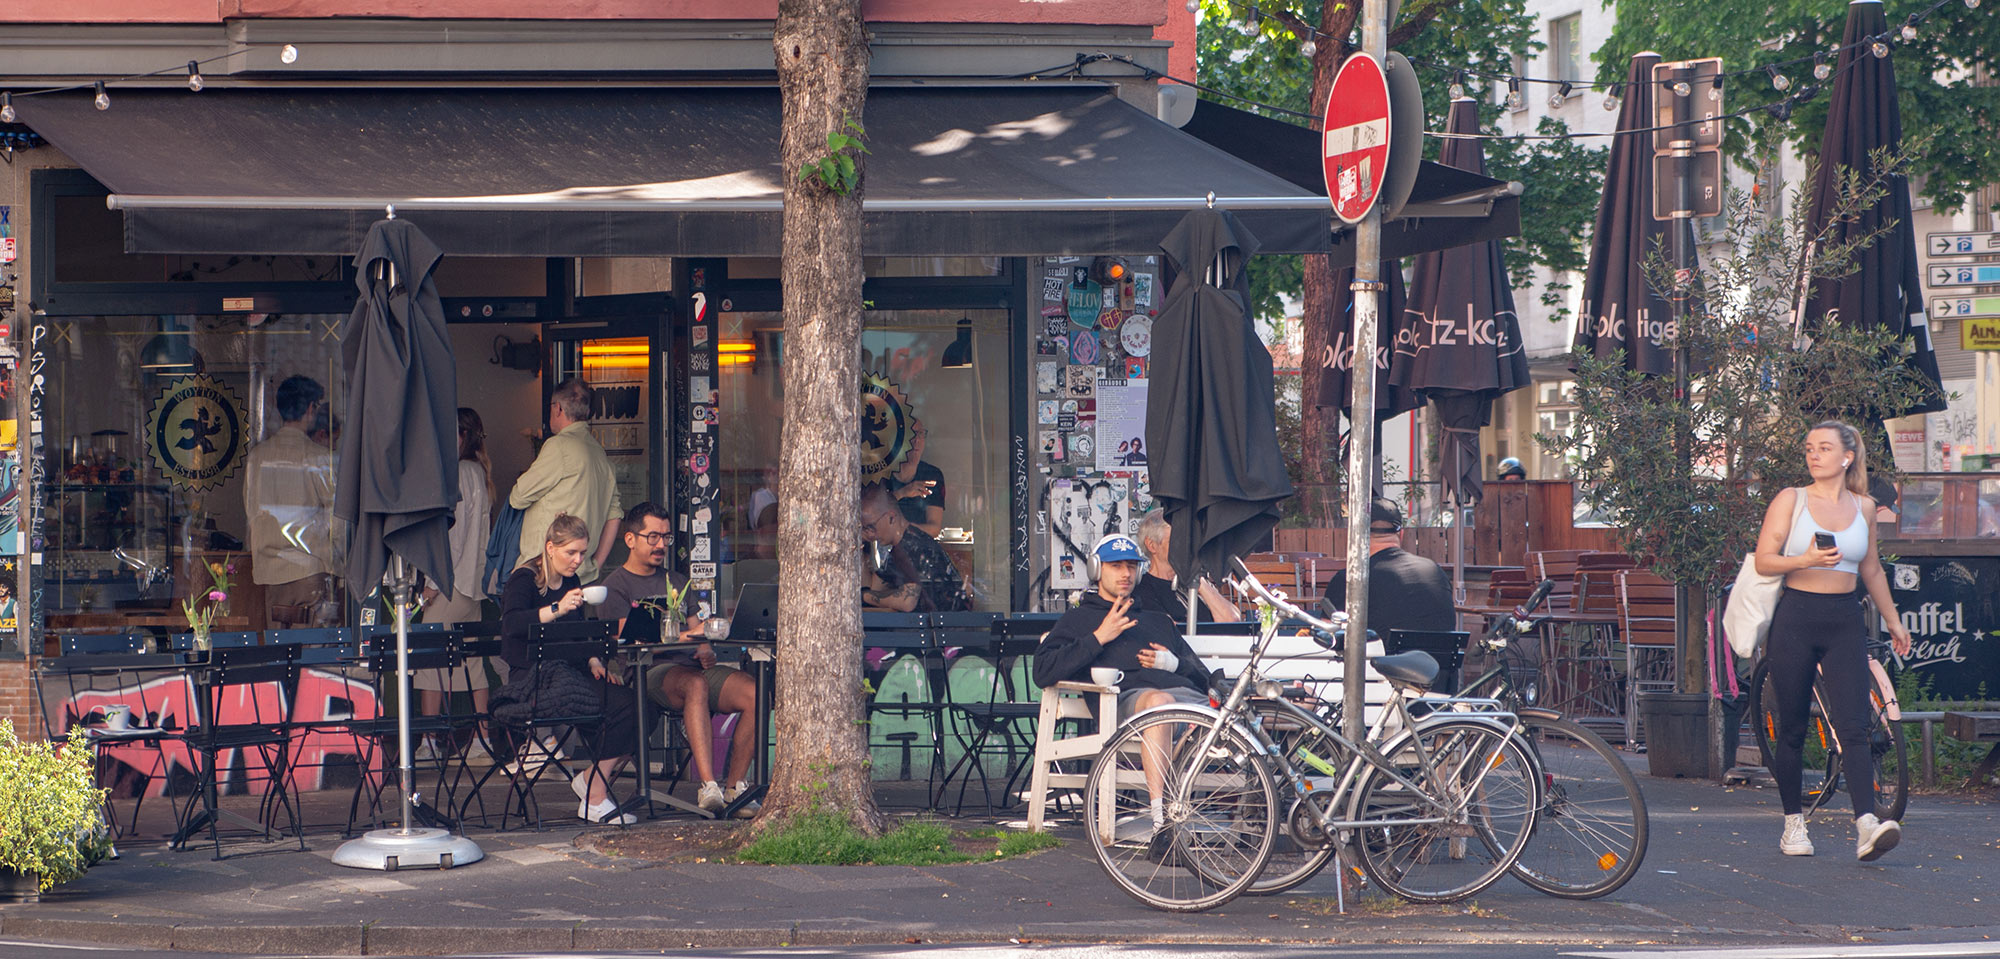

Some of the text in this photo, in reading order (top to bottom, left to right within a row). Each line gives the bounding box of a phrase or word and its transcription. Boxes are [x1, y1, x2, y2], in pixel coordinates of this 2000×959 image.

[1044, 279, 1062, 289] HOT
[1044, 289, 1061, 300] FIRE
[173, 387, 223, 403] WOYTON
[1895, 433, 1922, 442] REWE
[196, 464, 220, 479] 1998
[865, 460, 888, 474] 1998
